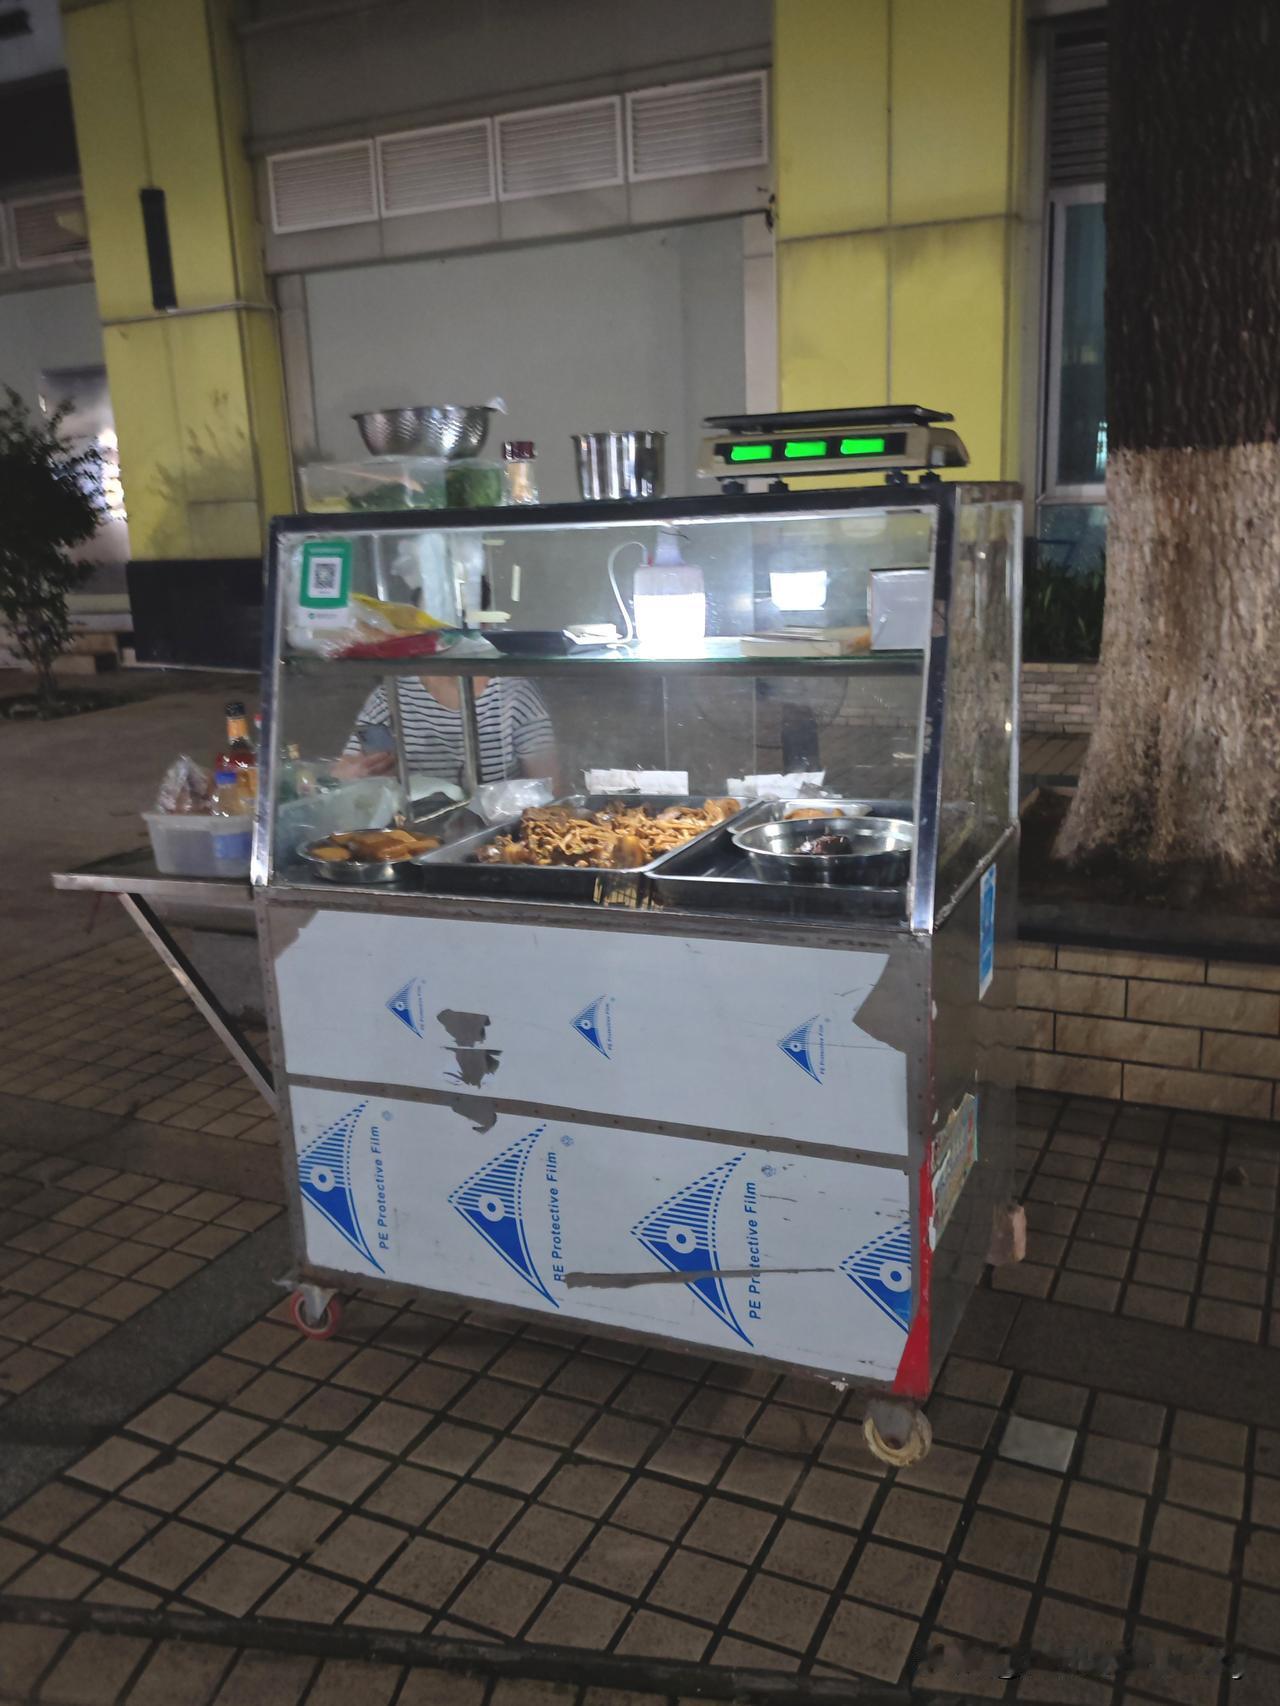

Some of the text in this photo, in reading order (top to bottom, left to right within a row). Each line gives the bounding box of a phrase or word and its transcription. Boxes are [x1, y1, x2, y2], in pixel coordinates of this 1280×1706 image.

[546, 1151, 558, 1182] Film
[370, 1125, 389, 1250] PE Protective Film
[743, 1181, 757, 1214] Film
[548, 1187, 562, 1260] Protective
[749, 1299, 762, 1320] PE
